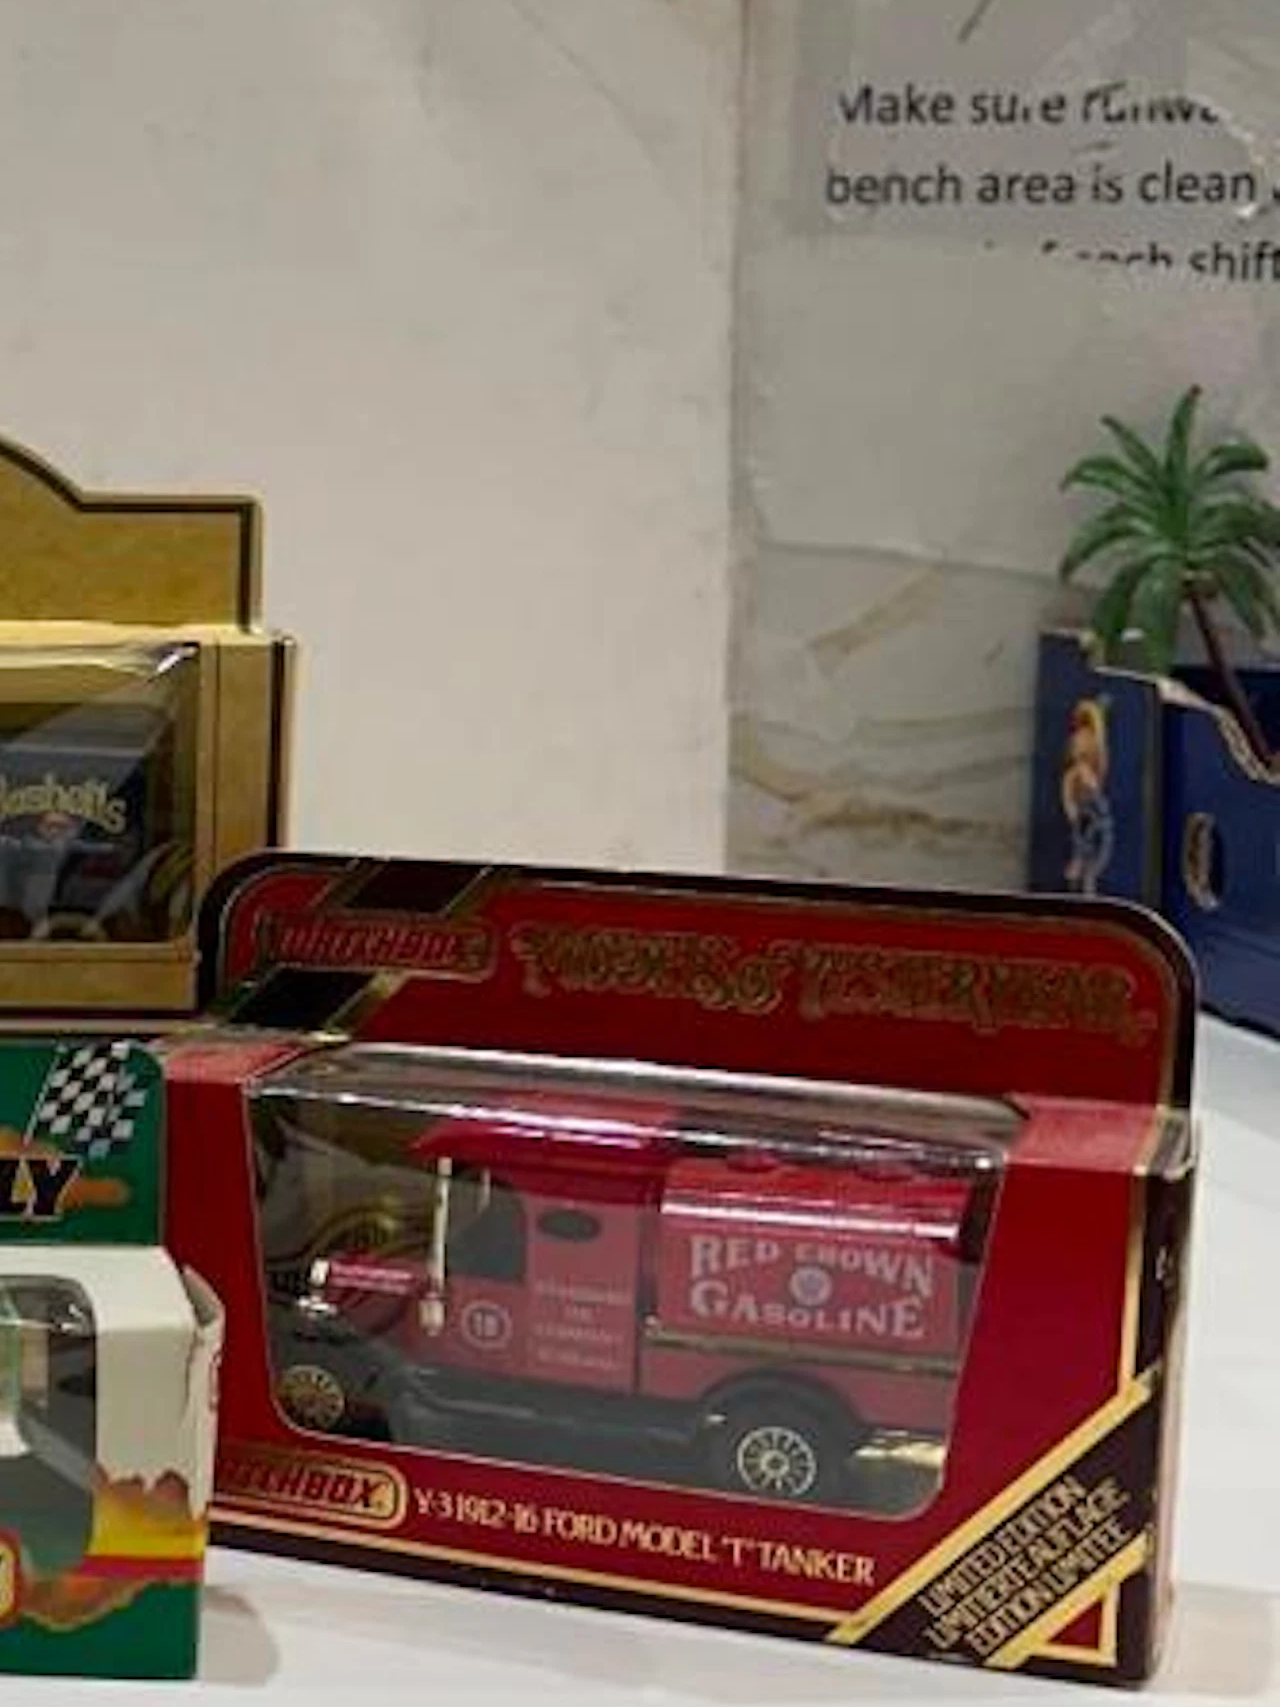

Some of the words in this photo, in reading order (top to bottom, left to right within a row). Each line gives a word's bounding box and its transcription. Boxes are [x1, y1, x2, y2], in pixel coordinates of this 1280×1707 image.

[826, 164, 962, 205] bench
[977, 173, 1076, 205] area
[1091, 162, 1125, 205] is
[1138, 160, 1256, 205] clean
[690, 1233, 781, 1279] RED
[794, 1242, 933, 1298] CROWN
[690, 1278, 925, 1340] GASOLINE
[543, 1506, 617, 1546] FORD
[617, 1519, 719, 1564] MODEL
[756, 1539, 876, 1587] TANKER
[919, 1539, 1007, 1617] LIMITED
[993, 1475, 1087, 1554] EDITION
